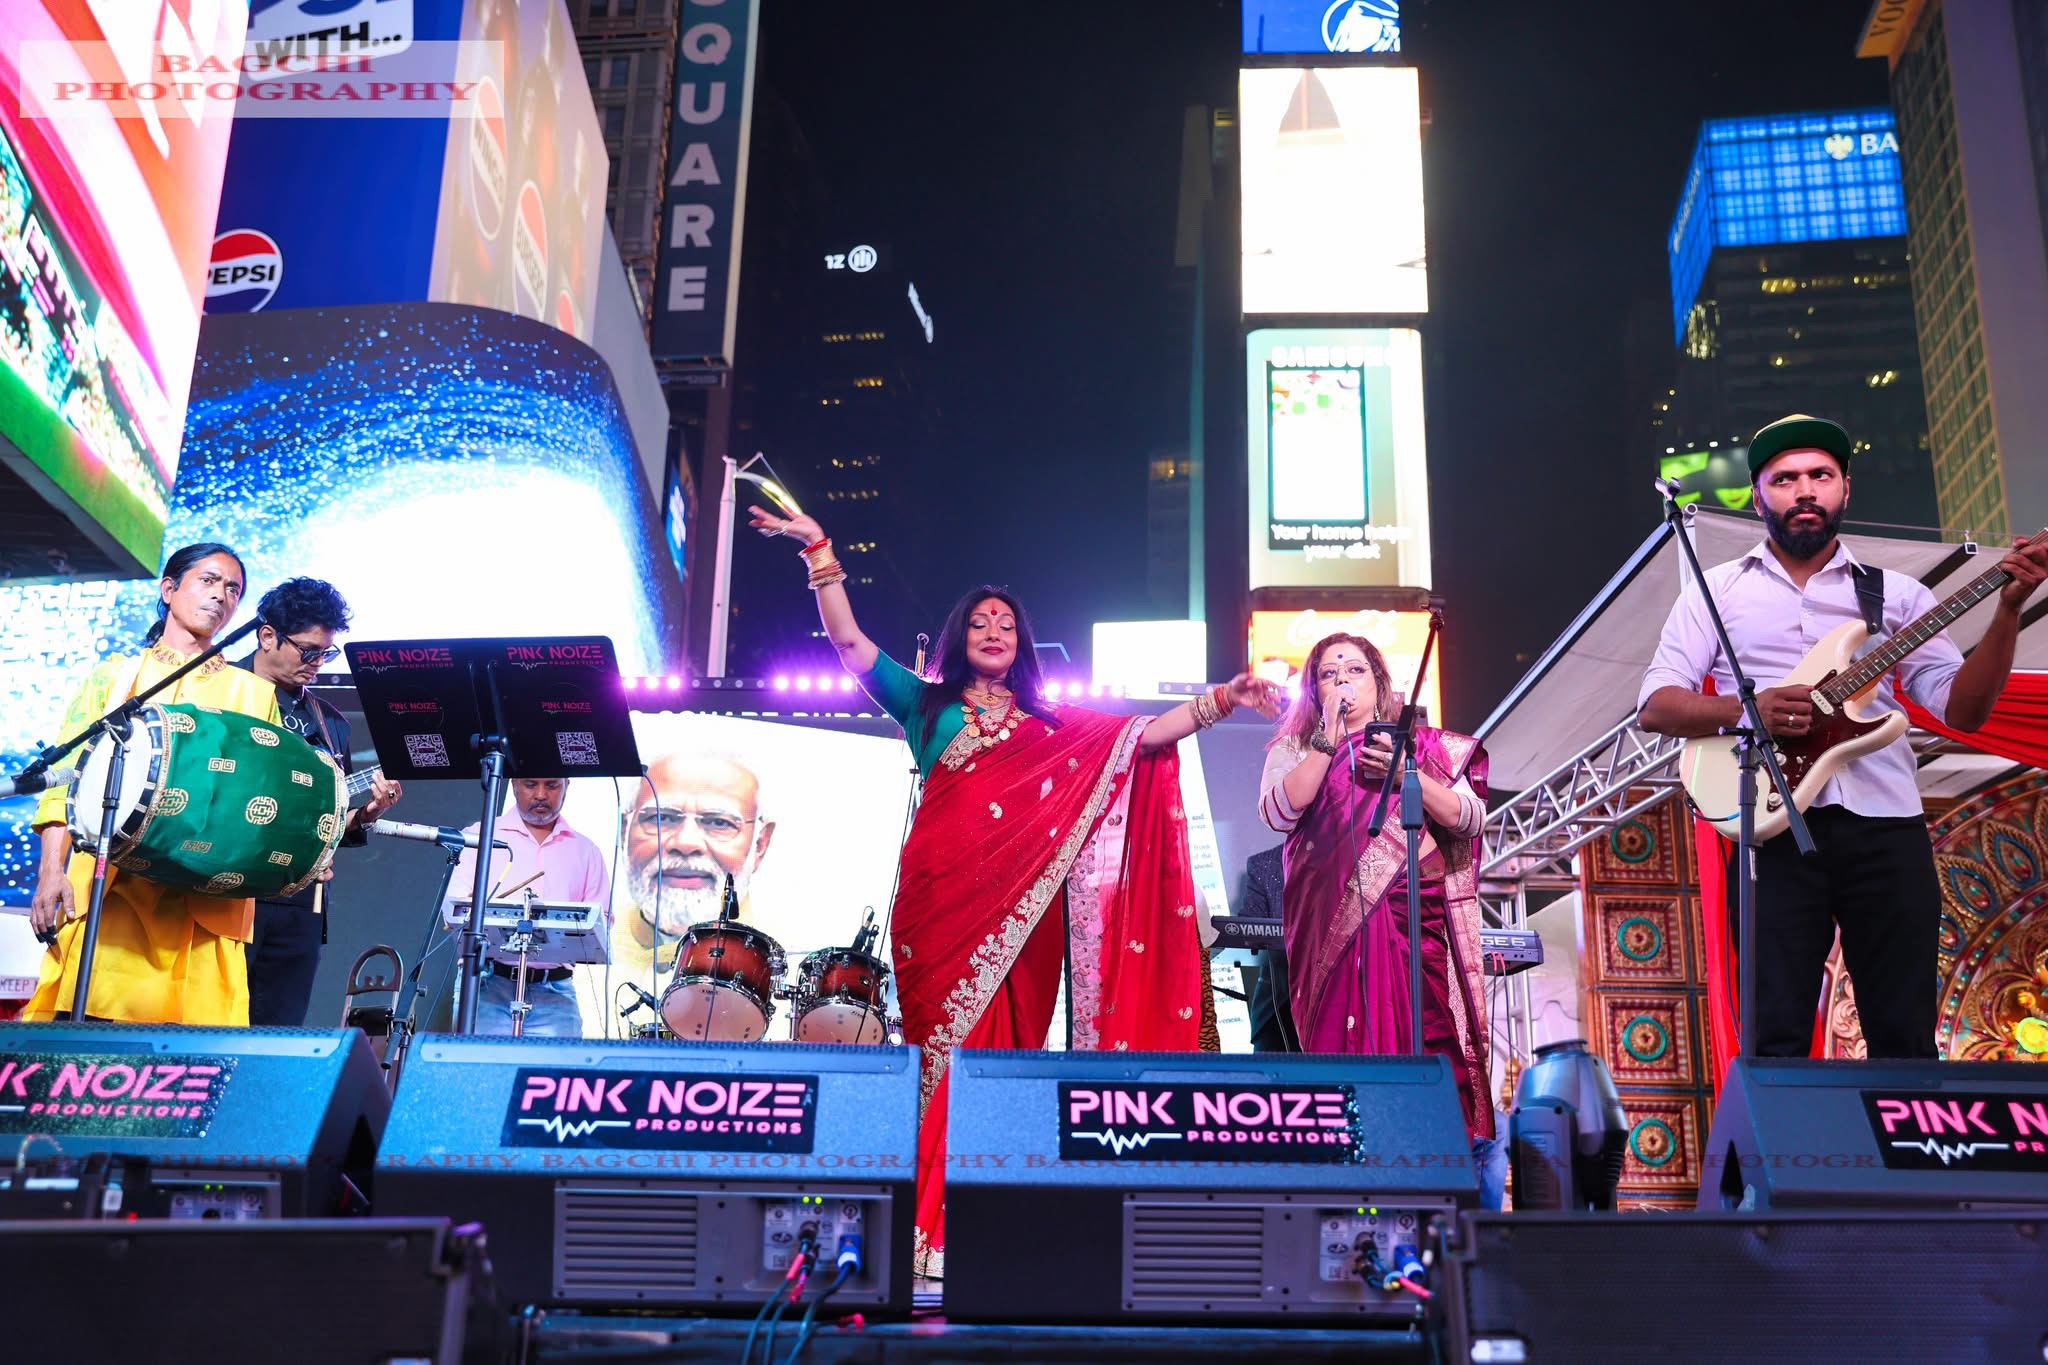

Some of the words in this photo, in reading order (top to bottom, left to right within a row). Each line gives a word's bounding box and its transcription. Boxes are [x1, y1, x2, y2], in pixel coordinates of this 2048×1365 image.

[667, 0, 732, 311] QUARE
[207, 264, 276, 286] EPSI
[1312, 525, 1363, 539] home
[356, 649, 394, 663] PINK
[397, 648, 452, 662] NOIZE
[506, 646, 544, 659] PINK
[548, 645, 603, 659] NOIZE
[49, 1063, 221, 1101] NOIZE
[521, 1076, 633, 1113] PINK
[648, 1079, 806, 1117] NOIZE
[30, 1103, 202, 1118] PRODUCTIONS
[1070, 1090, 1175, 1125] PINK
[1193, 1091, 1348, 1127] NOIZE
[1876, 1099, 1997, 1135] PINK
[635, 1118, 802, 1134] PRODUCTIONS
[1187, 1130, 1351, 1144] PRODUCTIONS
